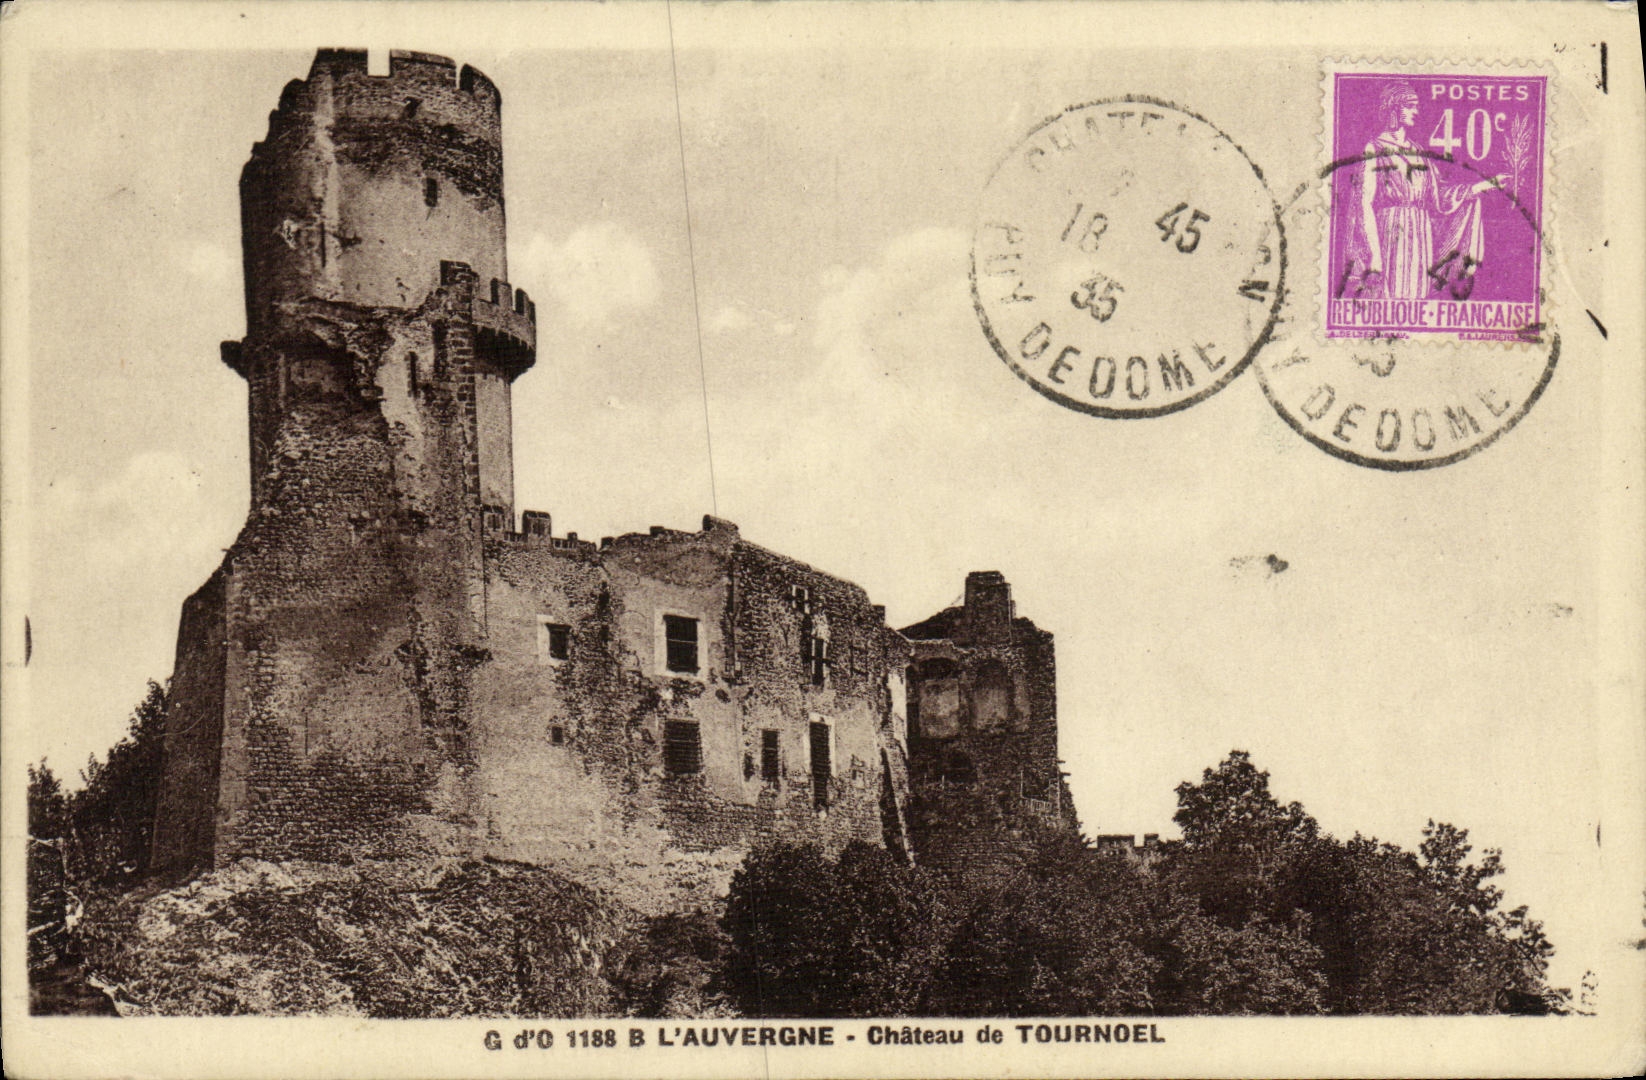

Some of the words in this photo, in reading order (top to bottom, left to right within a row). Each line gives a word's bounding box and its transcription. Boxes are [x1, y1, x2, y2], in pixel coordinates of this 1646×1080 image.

[1431, 84, 1529, 101] POSTES
[1154, 201, 1211, 254] 45
[484, 1029, 502, 1050] G
[566, 1028, 616, 1048] 1188
[629, 1028, 645, 1047] B
[658, 1026, 834, 1047] L'AUVERGNE
[867, 1024, 964, 1045] Château
[976, 1025, 1004, 1044] de
[1015, 1024, 1166, 1044] TOURNOEL
